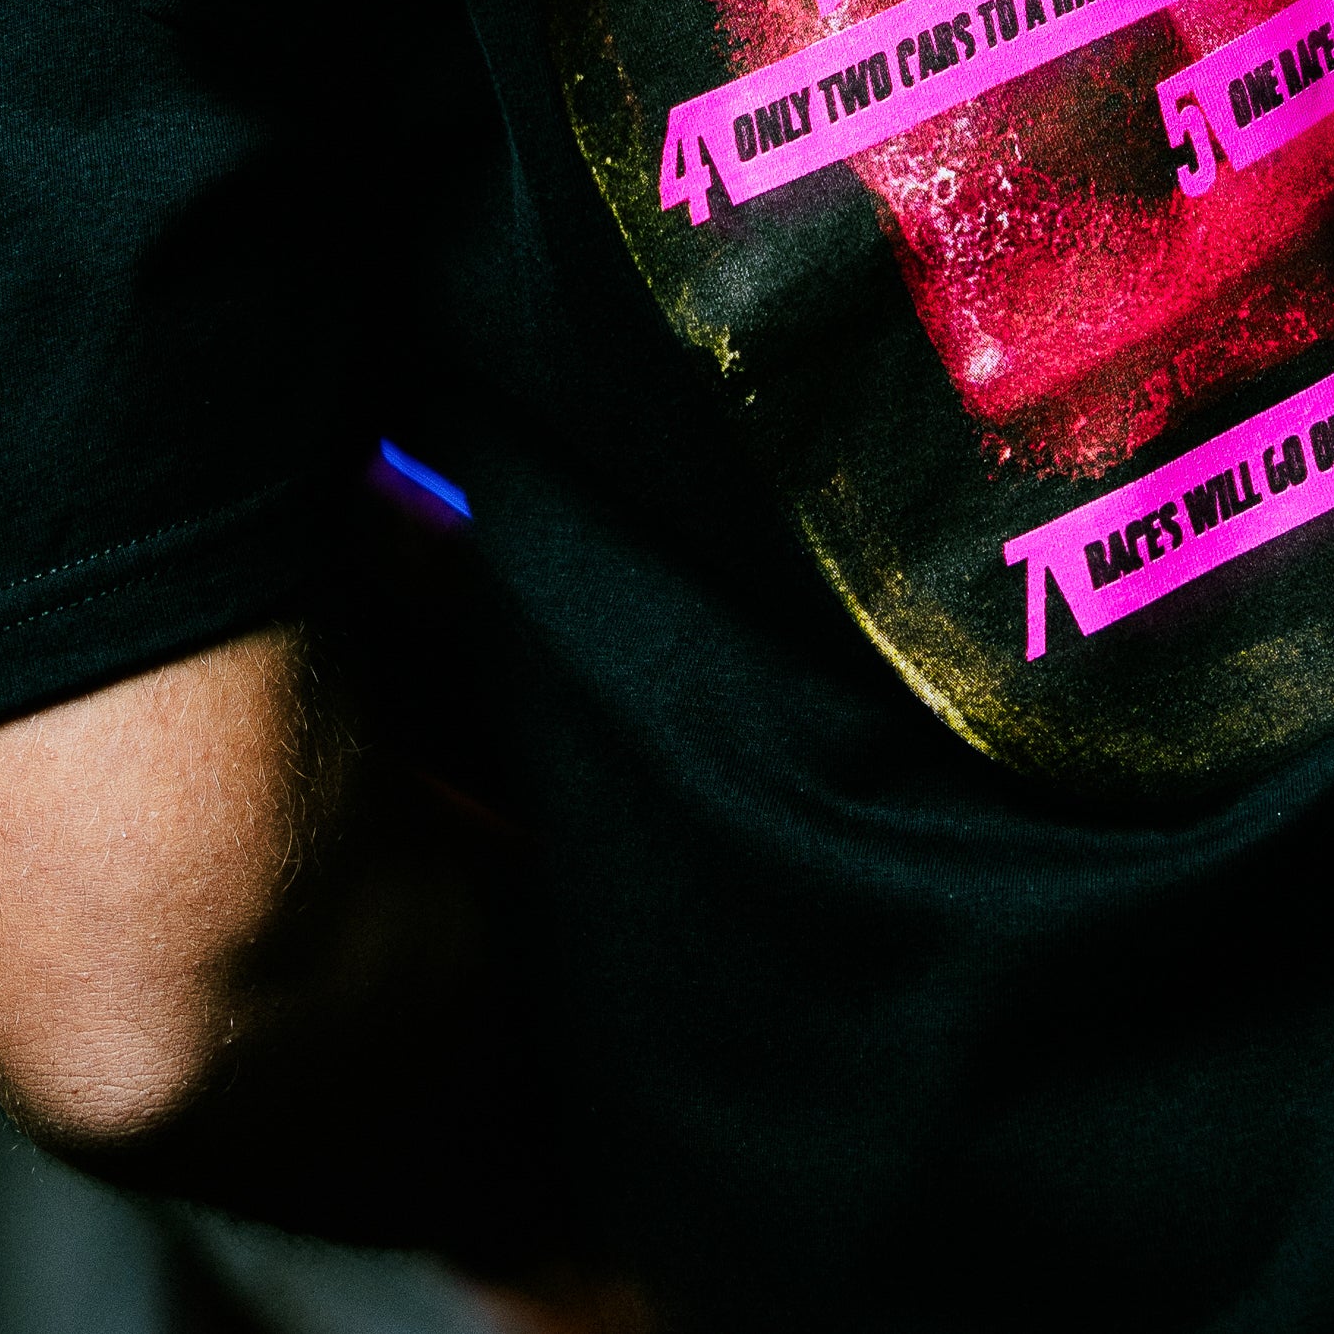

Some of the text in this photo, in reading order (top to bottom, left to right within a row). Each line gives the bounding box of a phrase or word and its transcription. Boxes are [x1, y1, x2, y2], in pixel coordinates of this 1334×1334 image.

[732, 86, 812, 163] ONLY
[818, 51, 893, 124] TWO
[897, 12, 976, 88] CARS
[1226, 60, 1280, 129] ONE
[1083, 499, 1184, 591] RACES
[1182, 461, 1263, 536] WILL
[1263, 435, 1307, 495] GO
